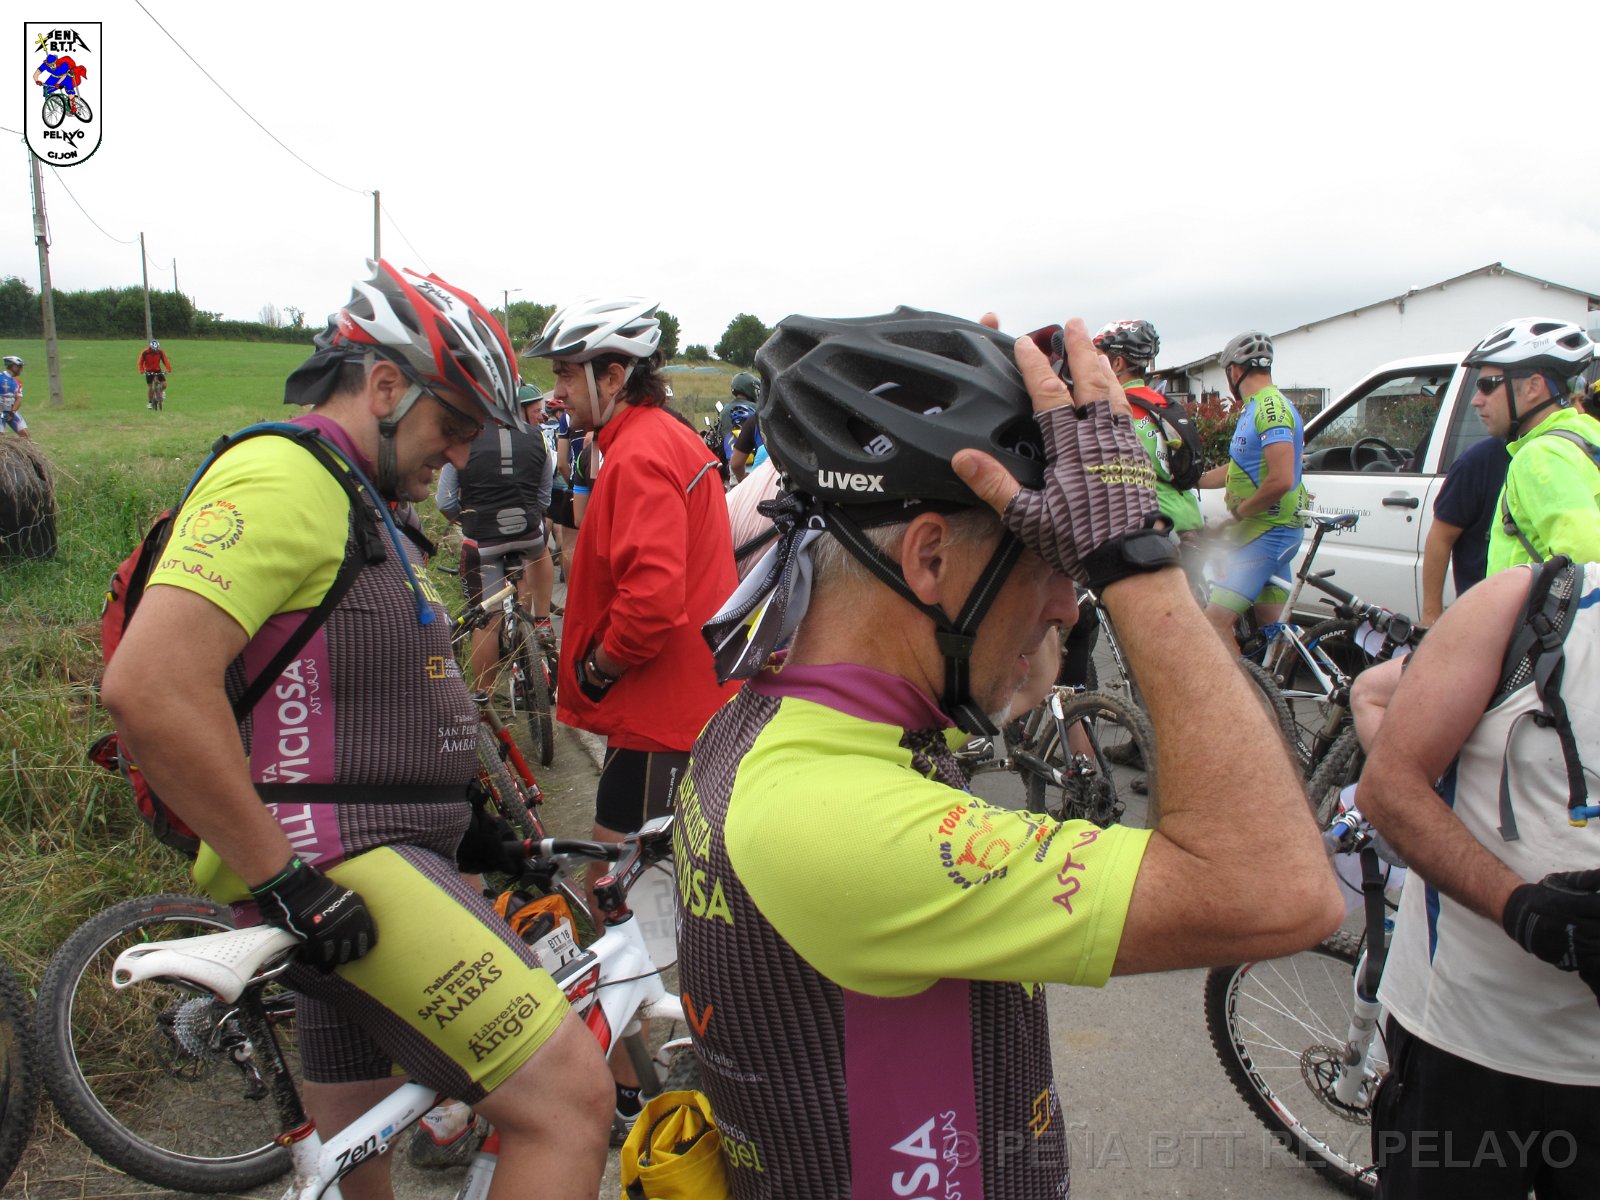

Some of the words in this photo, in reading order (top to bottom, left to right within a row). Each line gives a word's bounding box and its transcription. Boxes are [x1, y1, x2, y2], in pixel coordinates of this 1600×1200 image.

[818, 469, 884, 493] uvex
[1319, 629, 1347, 642] GIANT
[303, 657, 323, 716] ASTURIAS
[938, 805, 968, 836] TODO
[547, 934, 562, 949] BTT
[417, 994, 447, 1021] SAN
[444, 951, 494, 996] PEDRO
[423, 959, 466, 996] Talleres
[434, 964, 503, 1030] AMBÁS
[468, 992, 542, 1063] Ángel
[473, 994, 525, 1041] Librería
[335, 1133, 378, 1175] Zen
